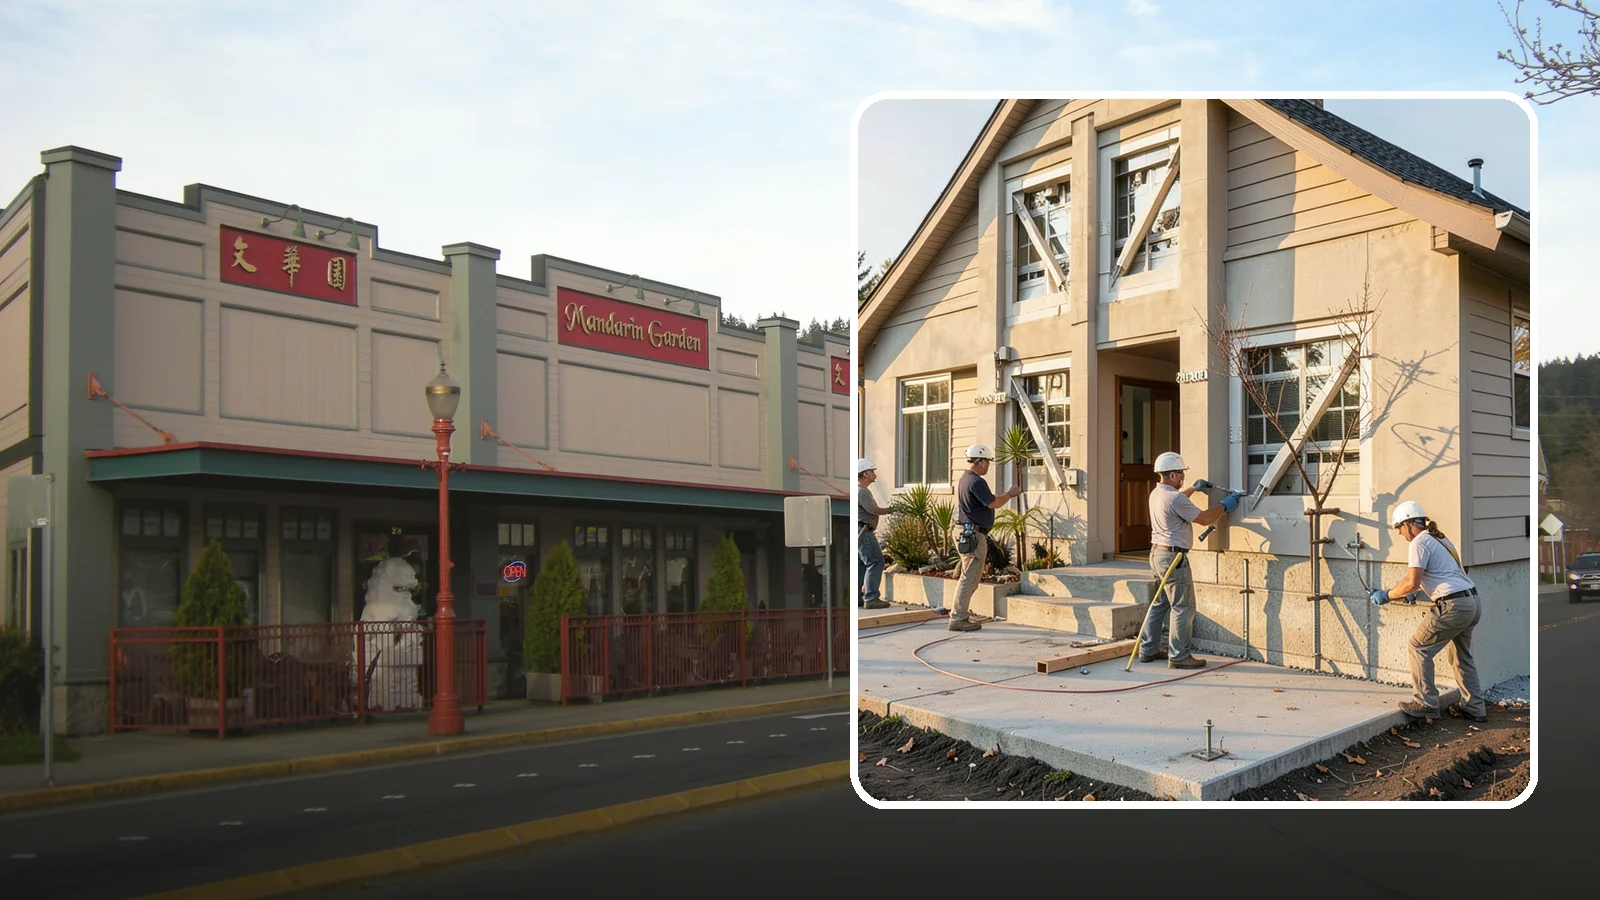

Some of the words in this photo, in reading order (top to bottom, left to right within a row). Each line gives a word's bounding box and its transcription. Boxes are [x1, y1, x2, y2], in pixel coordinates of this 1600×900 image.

[231, 236, 346, 291] 文華園
[565, 302, 644, 341] Mandarin
[648, 320, 701, 352] Garden
[503, 565, 527, 578] OPEN
